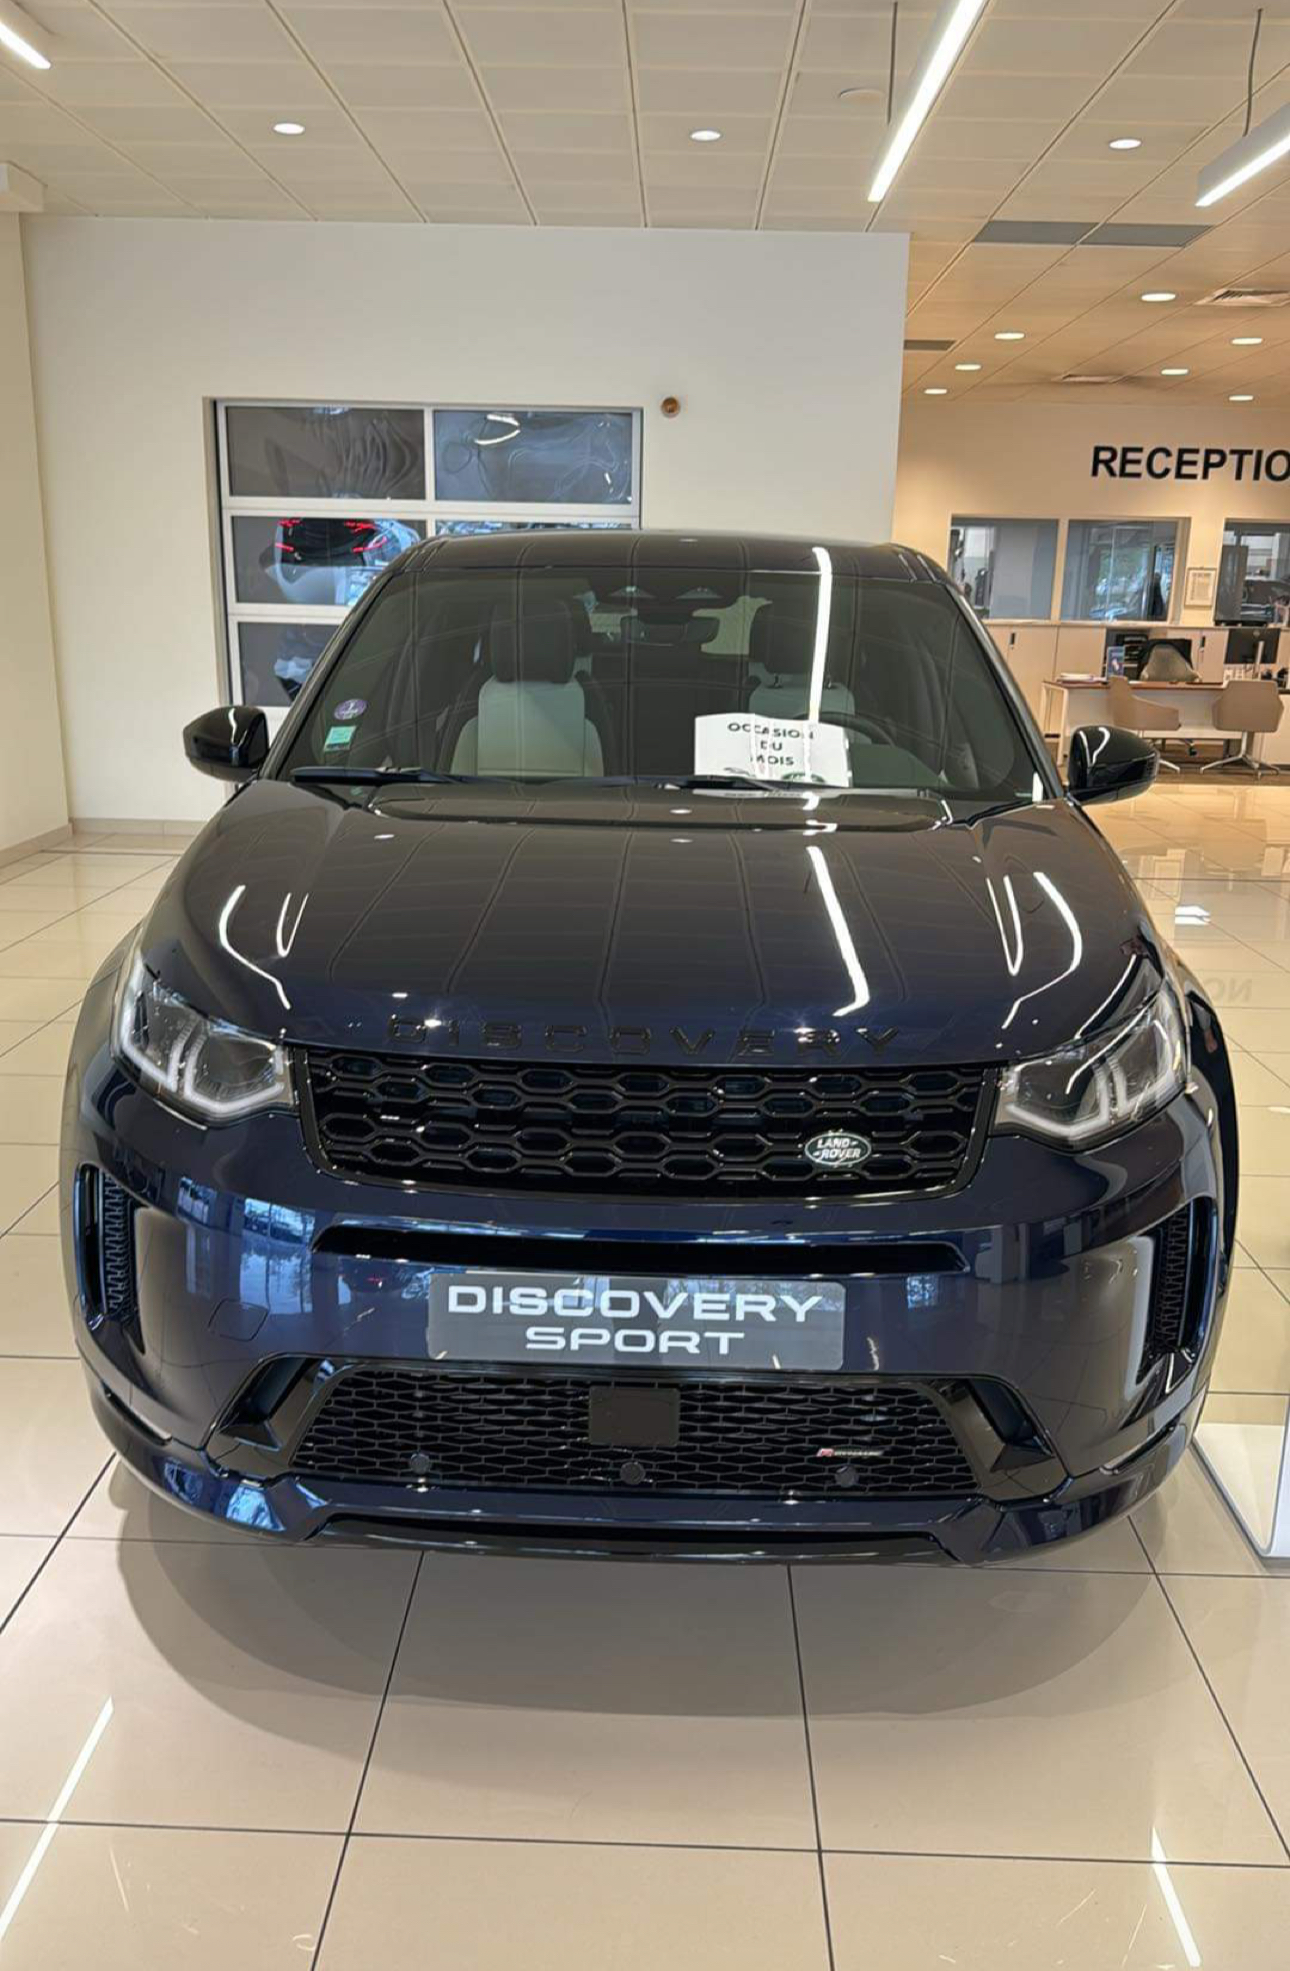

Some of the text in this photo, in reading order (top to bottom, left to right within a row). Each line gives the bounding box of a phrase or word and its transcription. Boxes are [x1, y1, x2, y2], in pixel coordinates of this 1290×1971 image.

[386, 1013, 901, 1057] DISCOVERY
[448, 1285, 823, 1322] DISCOVERY
[526, 1327, 745, 1354] SPORT
